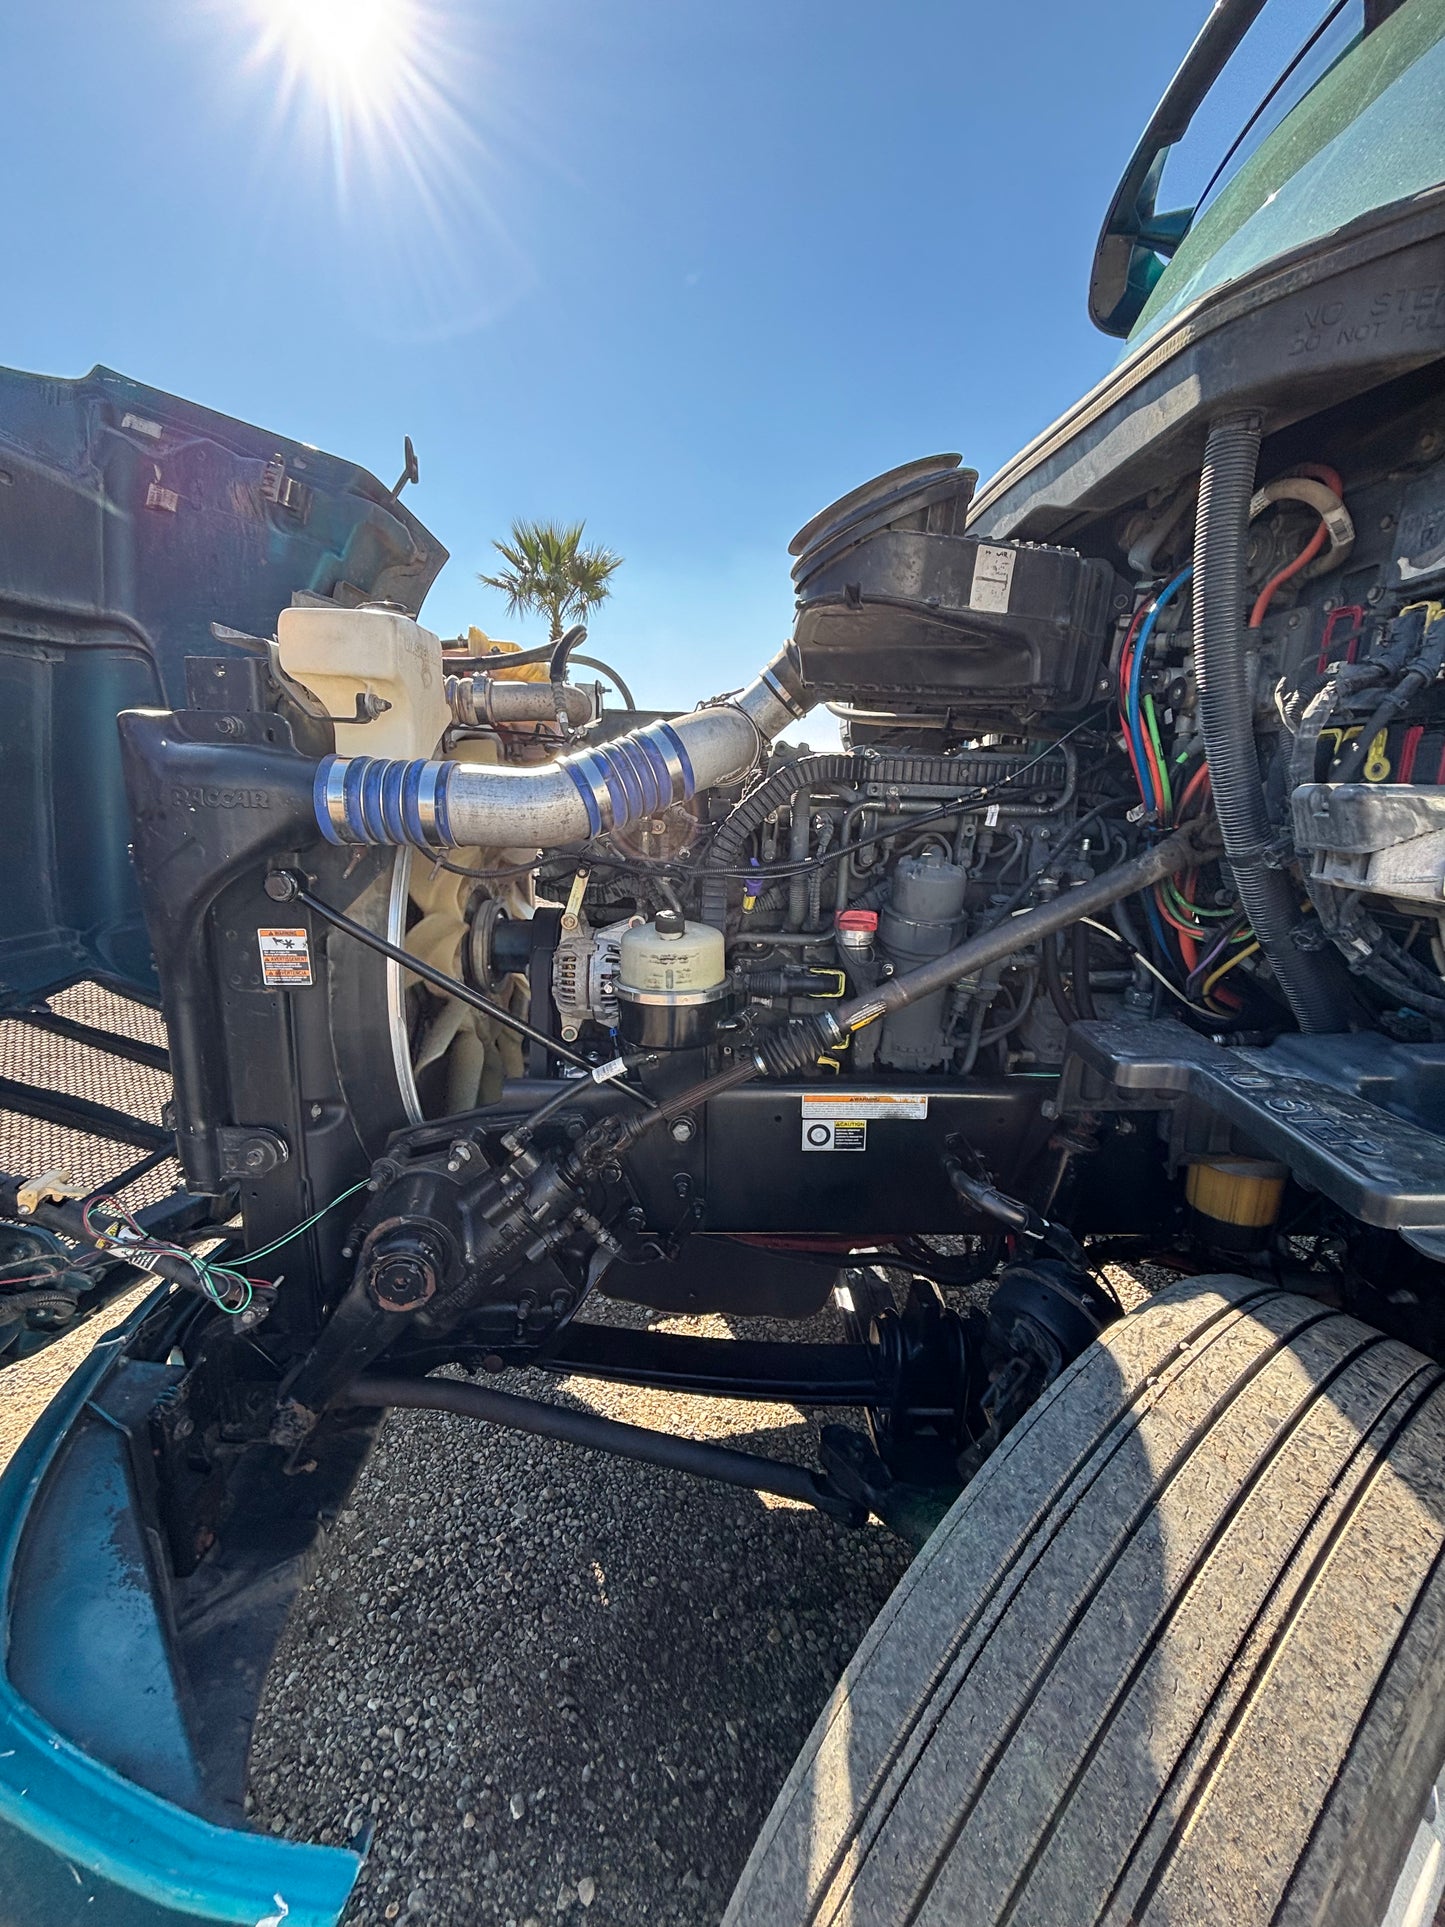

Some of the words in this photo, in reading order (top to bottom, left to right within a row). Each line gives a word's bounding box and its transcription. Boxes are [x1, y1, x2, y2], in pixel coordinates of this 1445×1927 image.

[1336, 321, 1387, 345] NOT
[1211, 1063, 1274, 1089] NO
[1264, 1097, 1384, 1161] STEP
